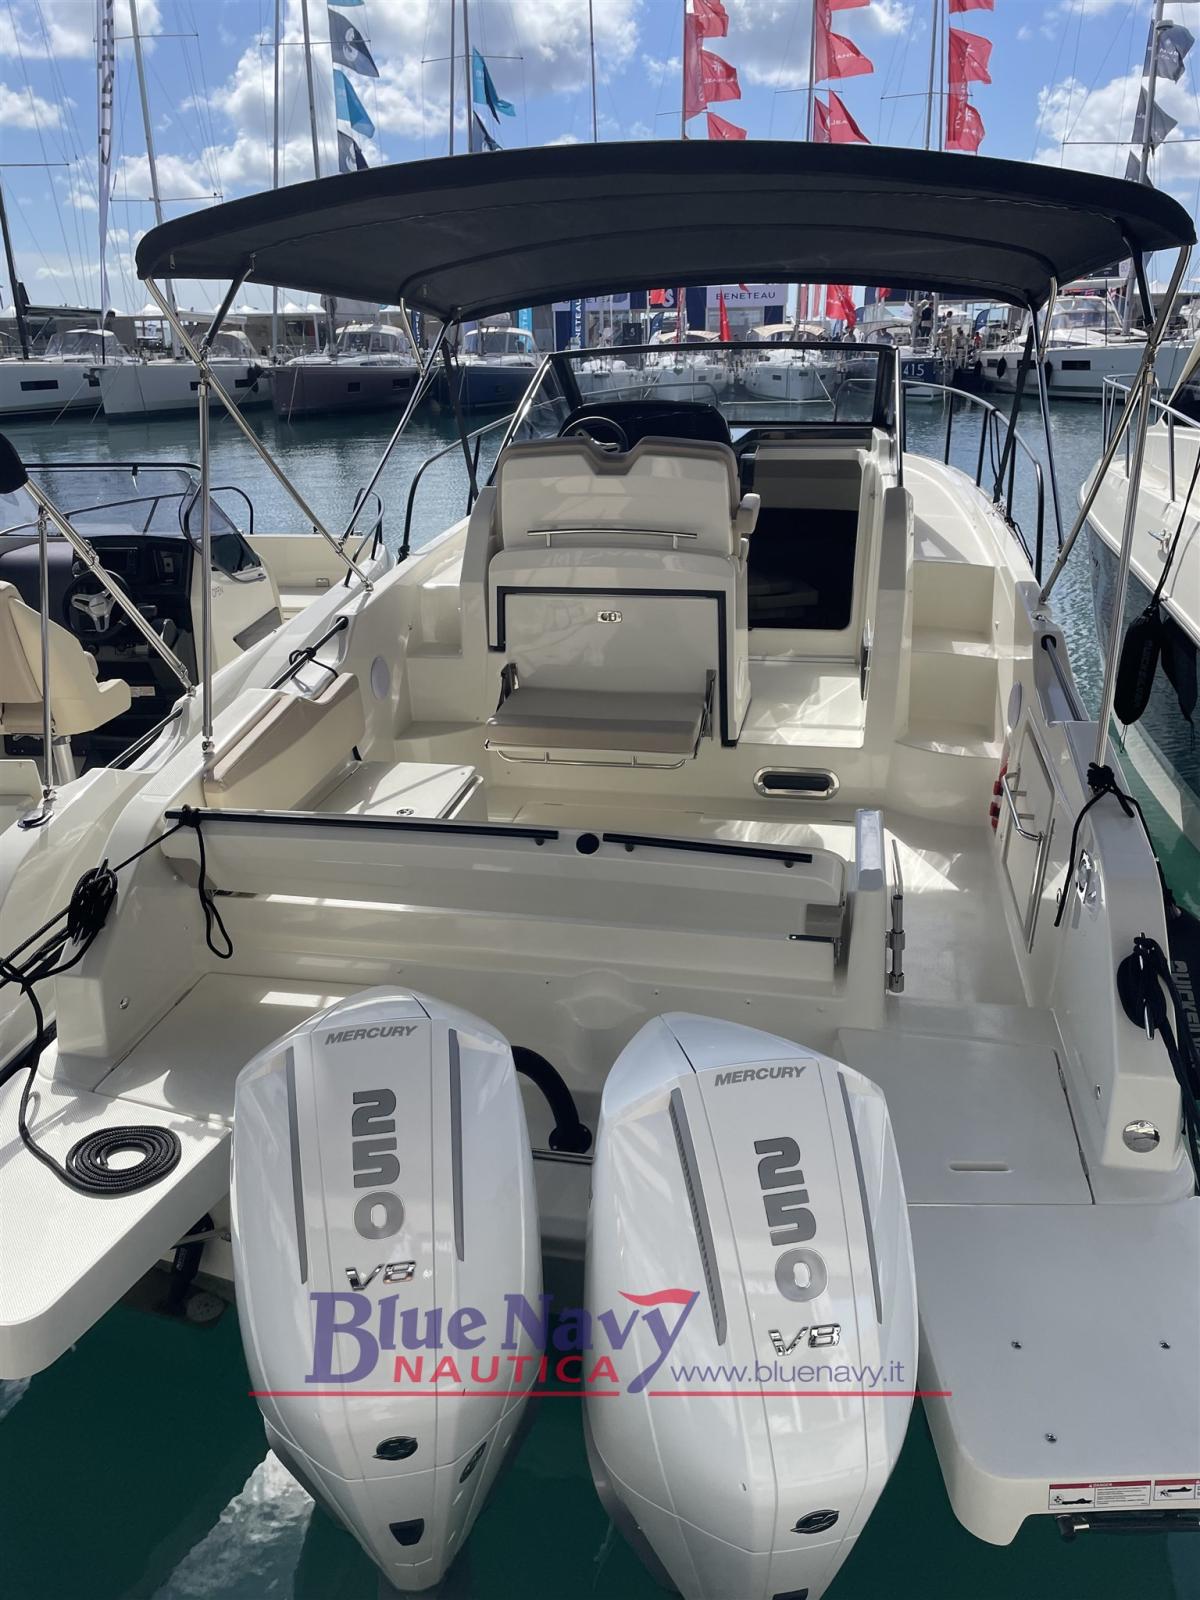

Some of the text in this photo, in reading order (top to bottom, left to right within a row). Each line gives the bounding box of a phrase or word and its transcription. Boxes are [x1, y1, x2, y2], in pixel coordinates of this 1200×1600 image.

[716, 292, 776, 301] BENETEAU
[903, 363, 925, 377] 415
[325, 1025, 418, 1045] MERCURY
[714, 1066, 807, 1087] MERCURY
[352, 1088, 404, 1239] 250
[754, 1136, 828, 1302] 250
[345, 1260, 416, 1291] V8
[768, 1323, 841, 1356] V8
